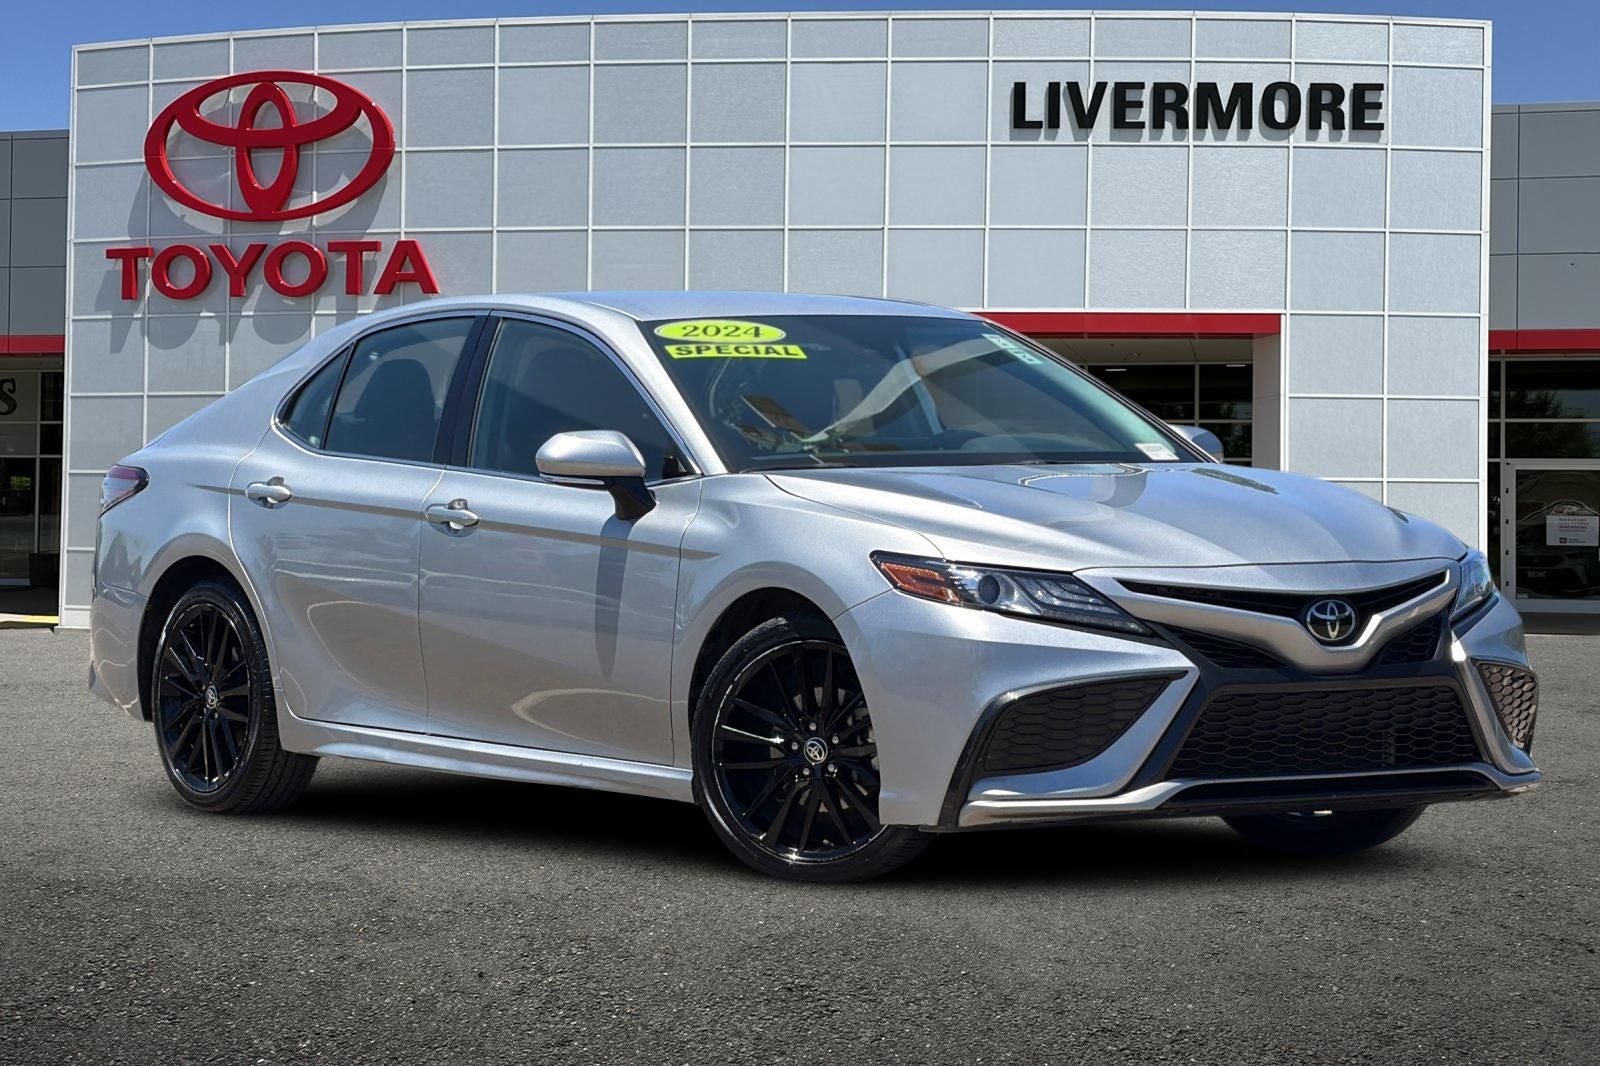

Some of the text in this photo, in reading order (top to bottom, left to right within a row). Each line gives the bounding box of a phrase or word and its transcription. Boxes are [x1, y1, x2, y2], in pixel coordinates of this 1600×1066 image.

[1012, 81, 1385, 131] LIVERMORE
[105, 240, 441, 300] TOYOTA
[681, 325, 763, 338] 2024
[675, 345, 798, 356] SPECIAL
